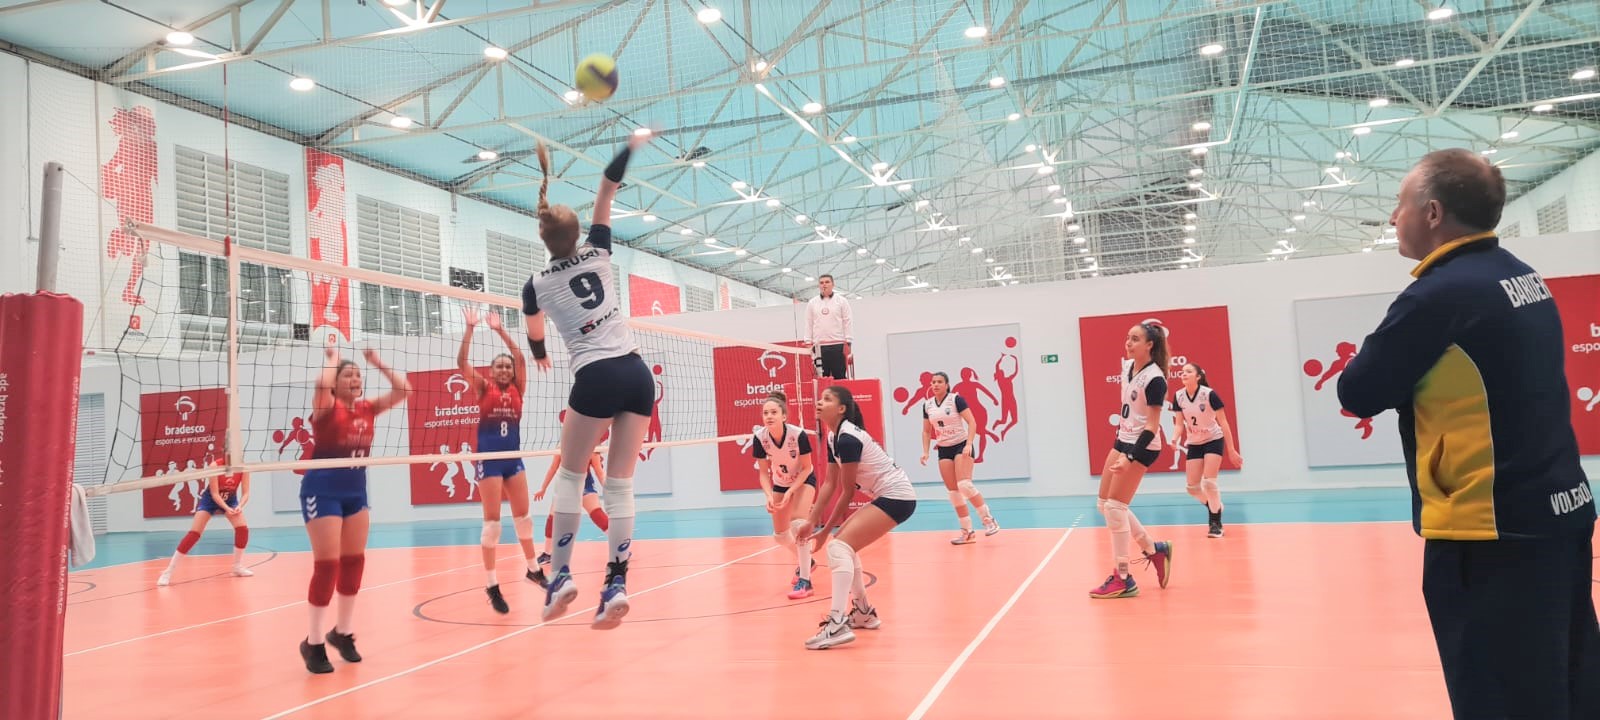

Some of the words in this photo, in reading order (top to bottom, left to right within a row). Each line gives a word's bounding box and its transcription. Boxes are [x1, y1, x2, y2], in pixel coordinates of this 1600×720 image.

[569, 272, 605, 310] 9
[434, 404, 480, 417] bradesco
[460, 416, 480, 425] educa
[1191, 416, 1198, 426] 2
[164, 424, 206, 436] bradesco
[500, 421, 508, 437] 8
